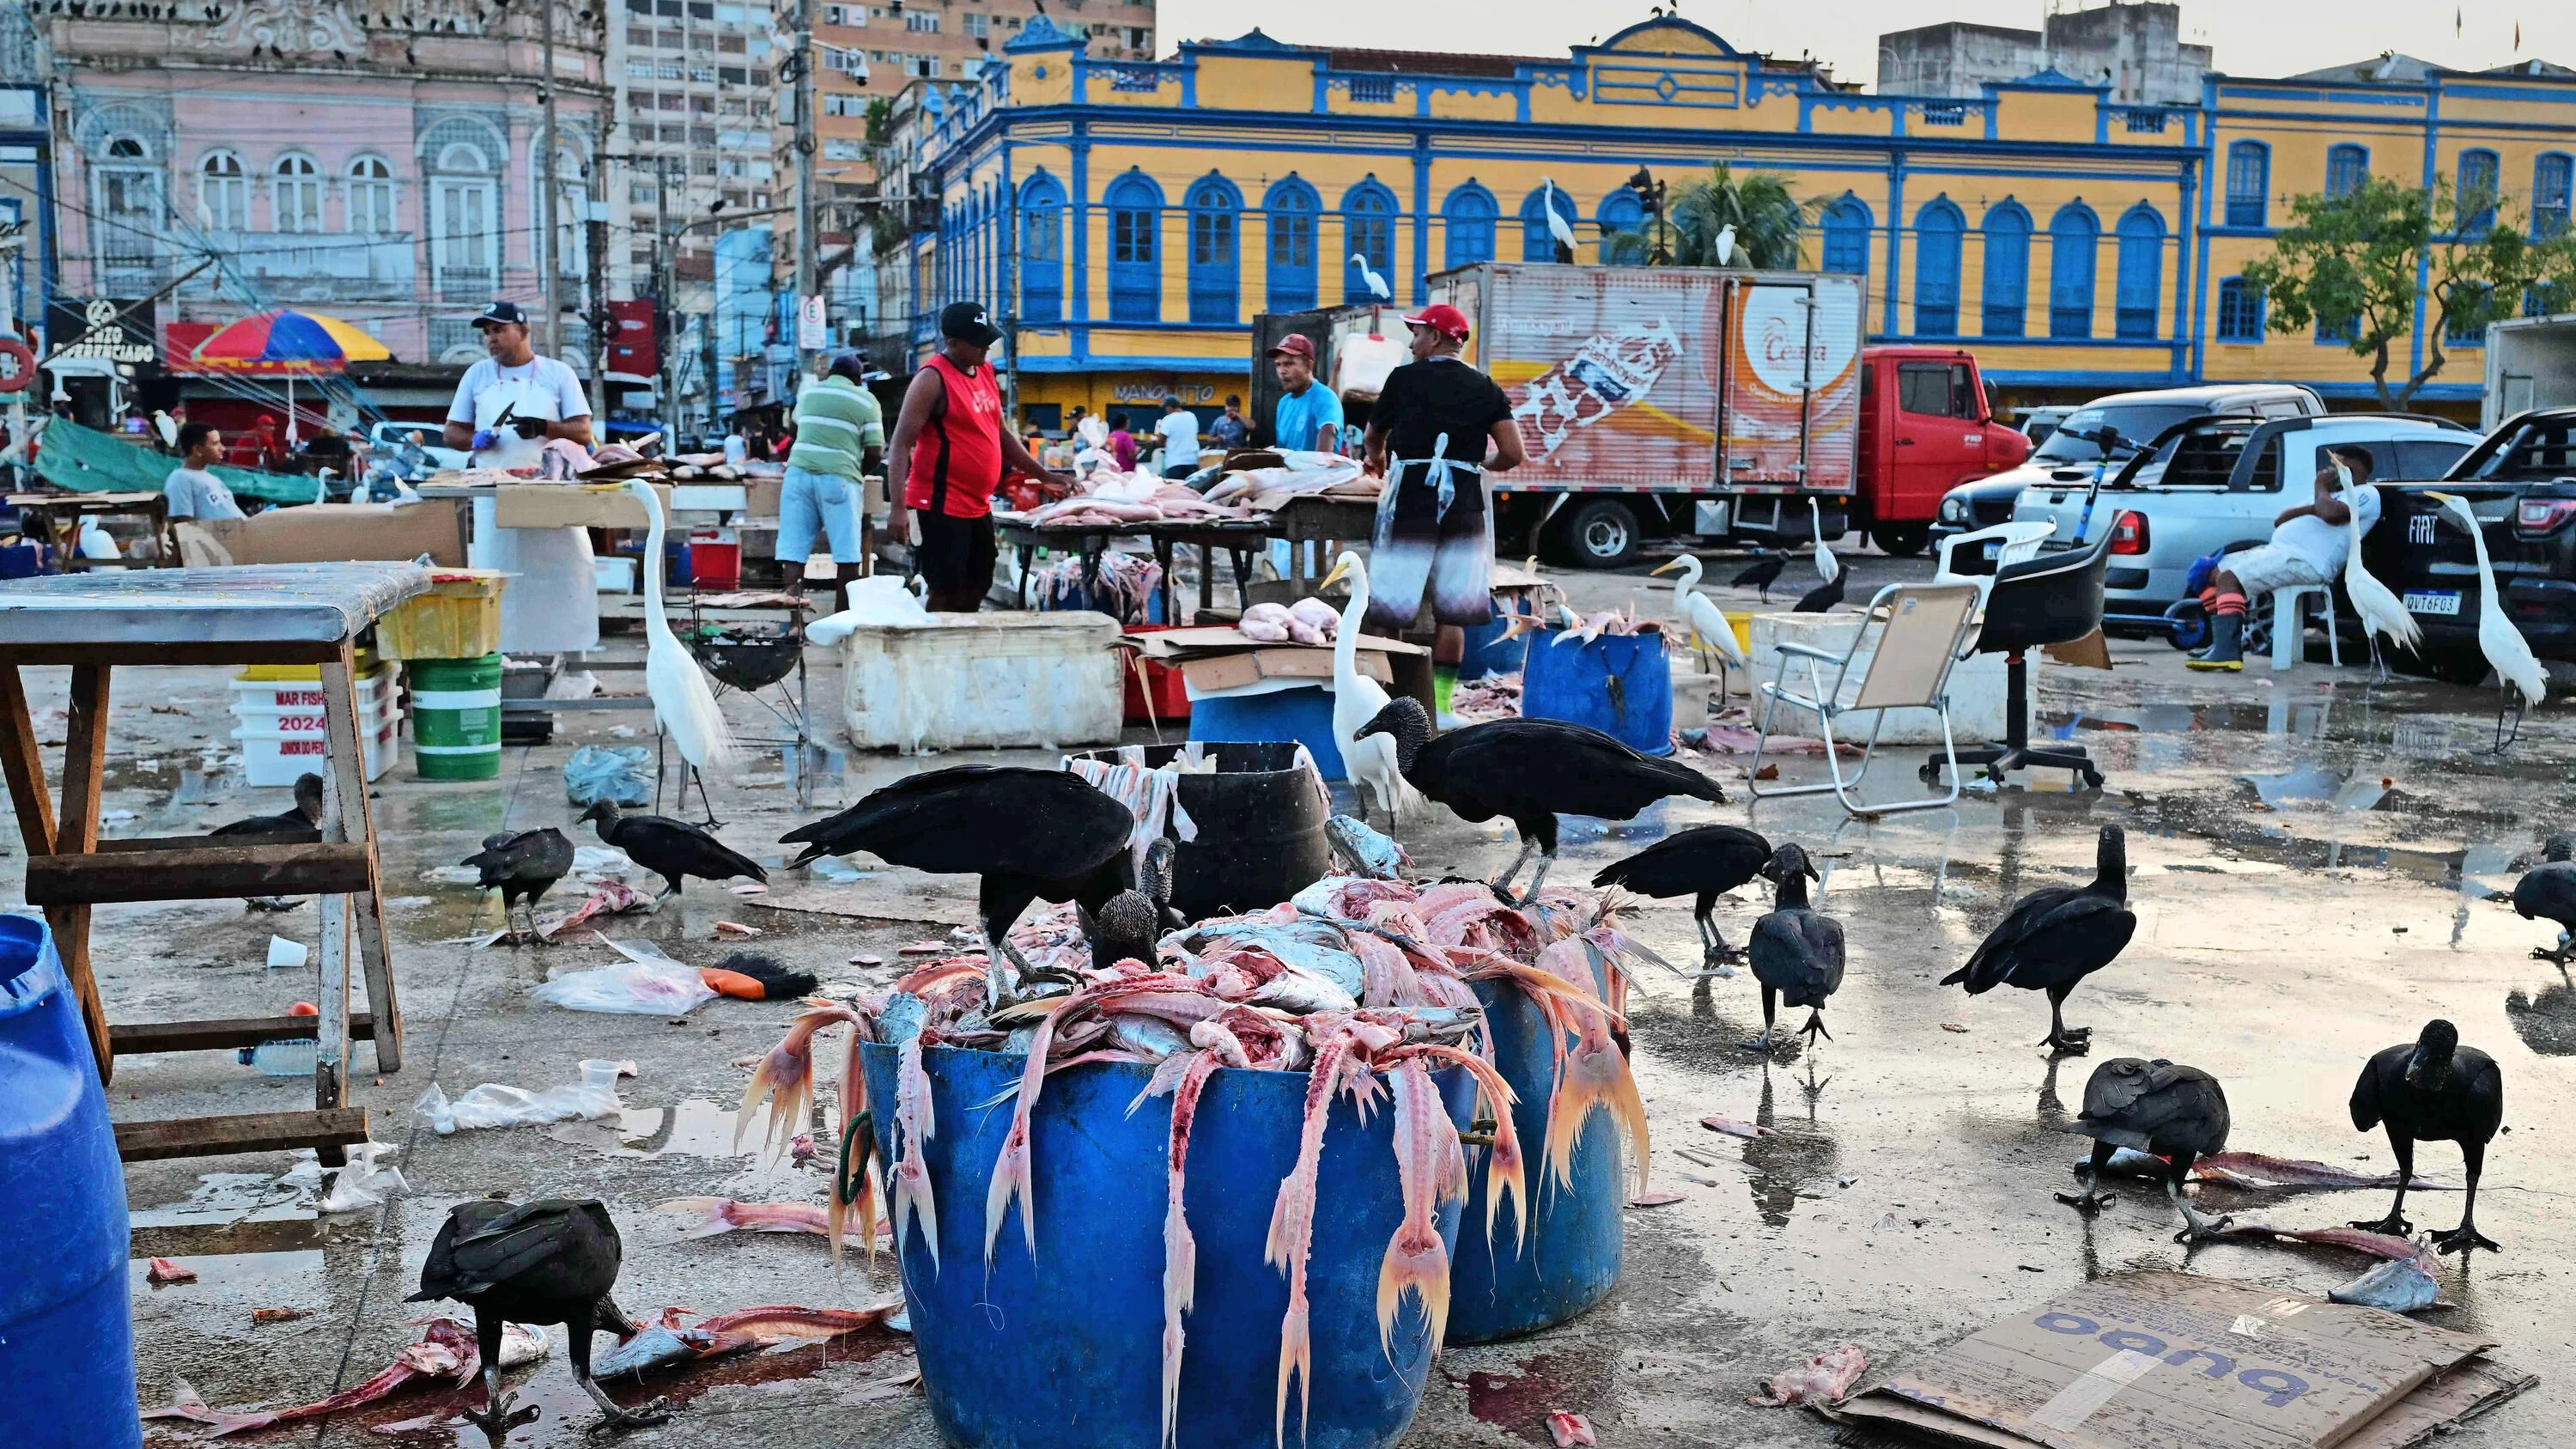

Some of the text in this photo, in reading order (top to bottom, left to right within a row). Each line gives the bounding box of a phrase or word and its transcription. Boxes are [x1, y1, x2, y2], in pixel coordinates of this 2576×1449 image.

[2409, 515, 2438, 545] FIAT
[2408, 596, 2453, 612] QVT6F03
[276, 691, 299, 706] MAR
[278, 716, 325, 731] 2024
